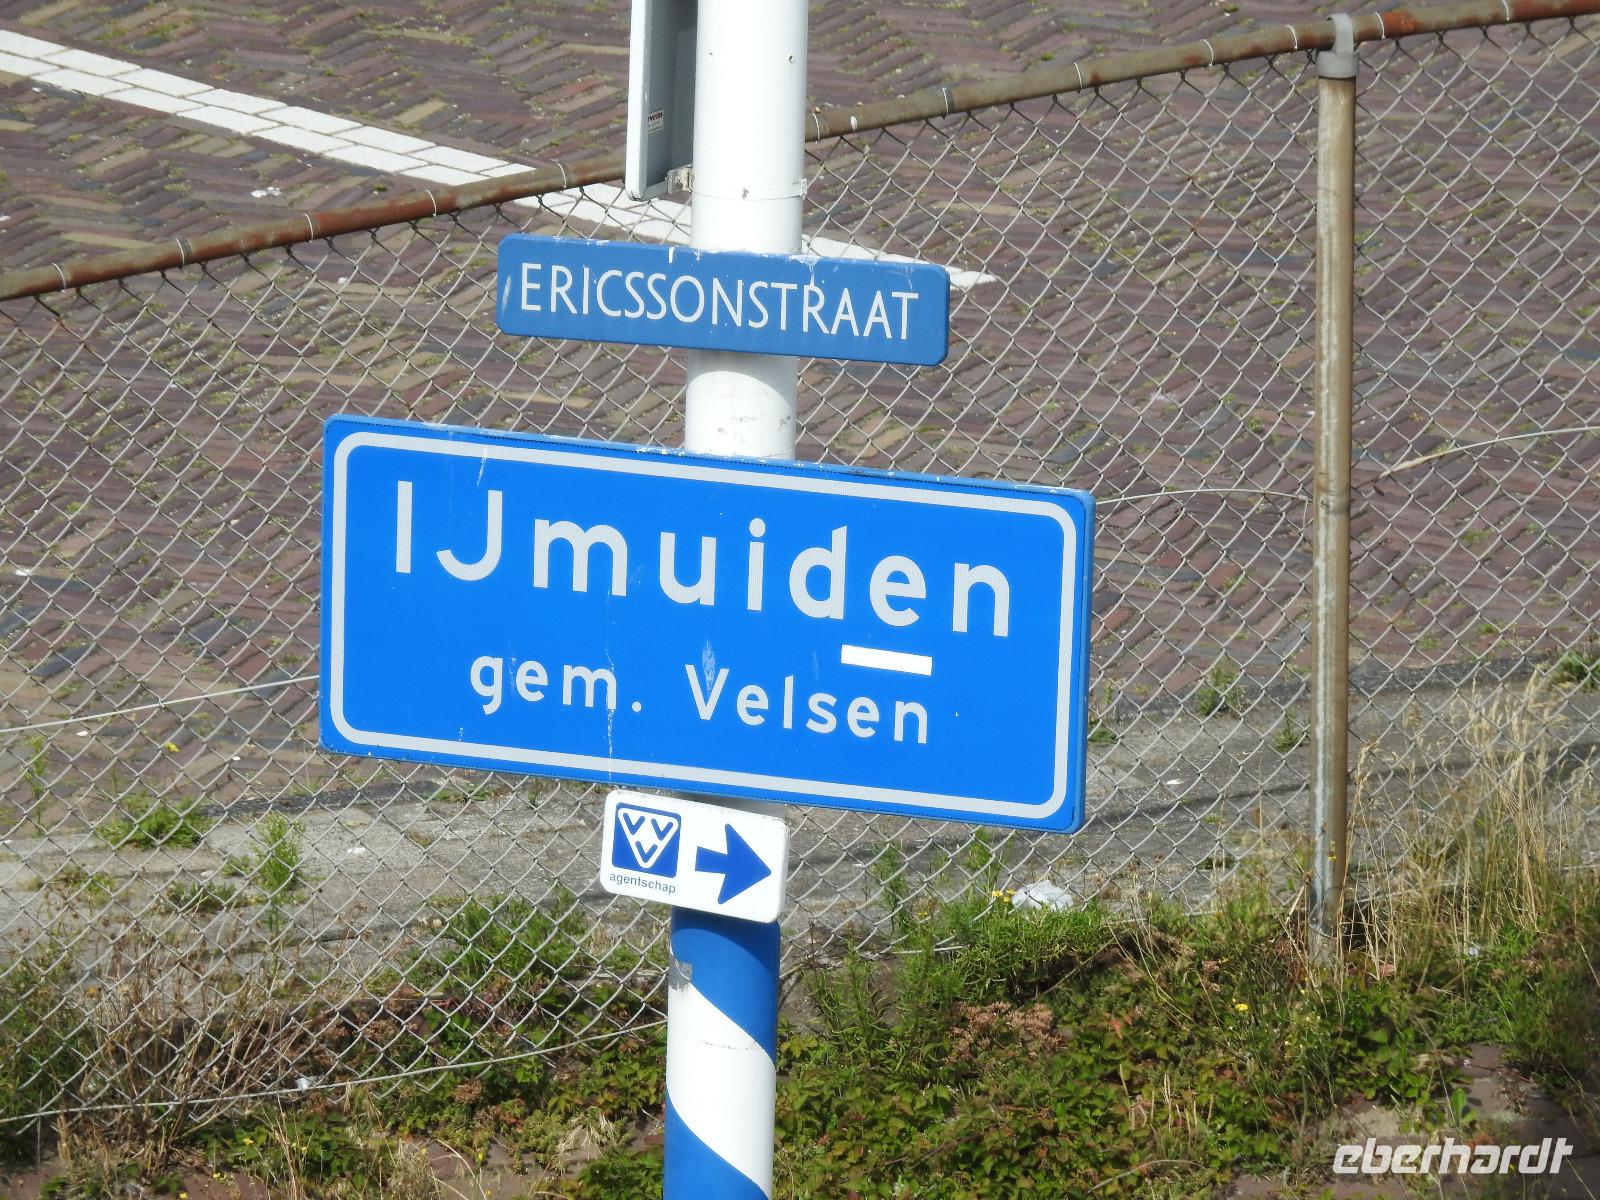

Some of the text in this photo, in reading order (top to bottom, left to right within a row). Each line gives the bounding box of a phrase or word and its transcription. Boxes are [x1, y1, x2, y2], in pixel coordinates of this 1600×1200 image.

[521, 262, 919, 341] ERICSSONSTRAAT
[395, 480, 1011, 638] IJmuiden
[470, 655, 929, 745] gem. Velsen
[609, 872, 677, 896] agentschap
